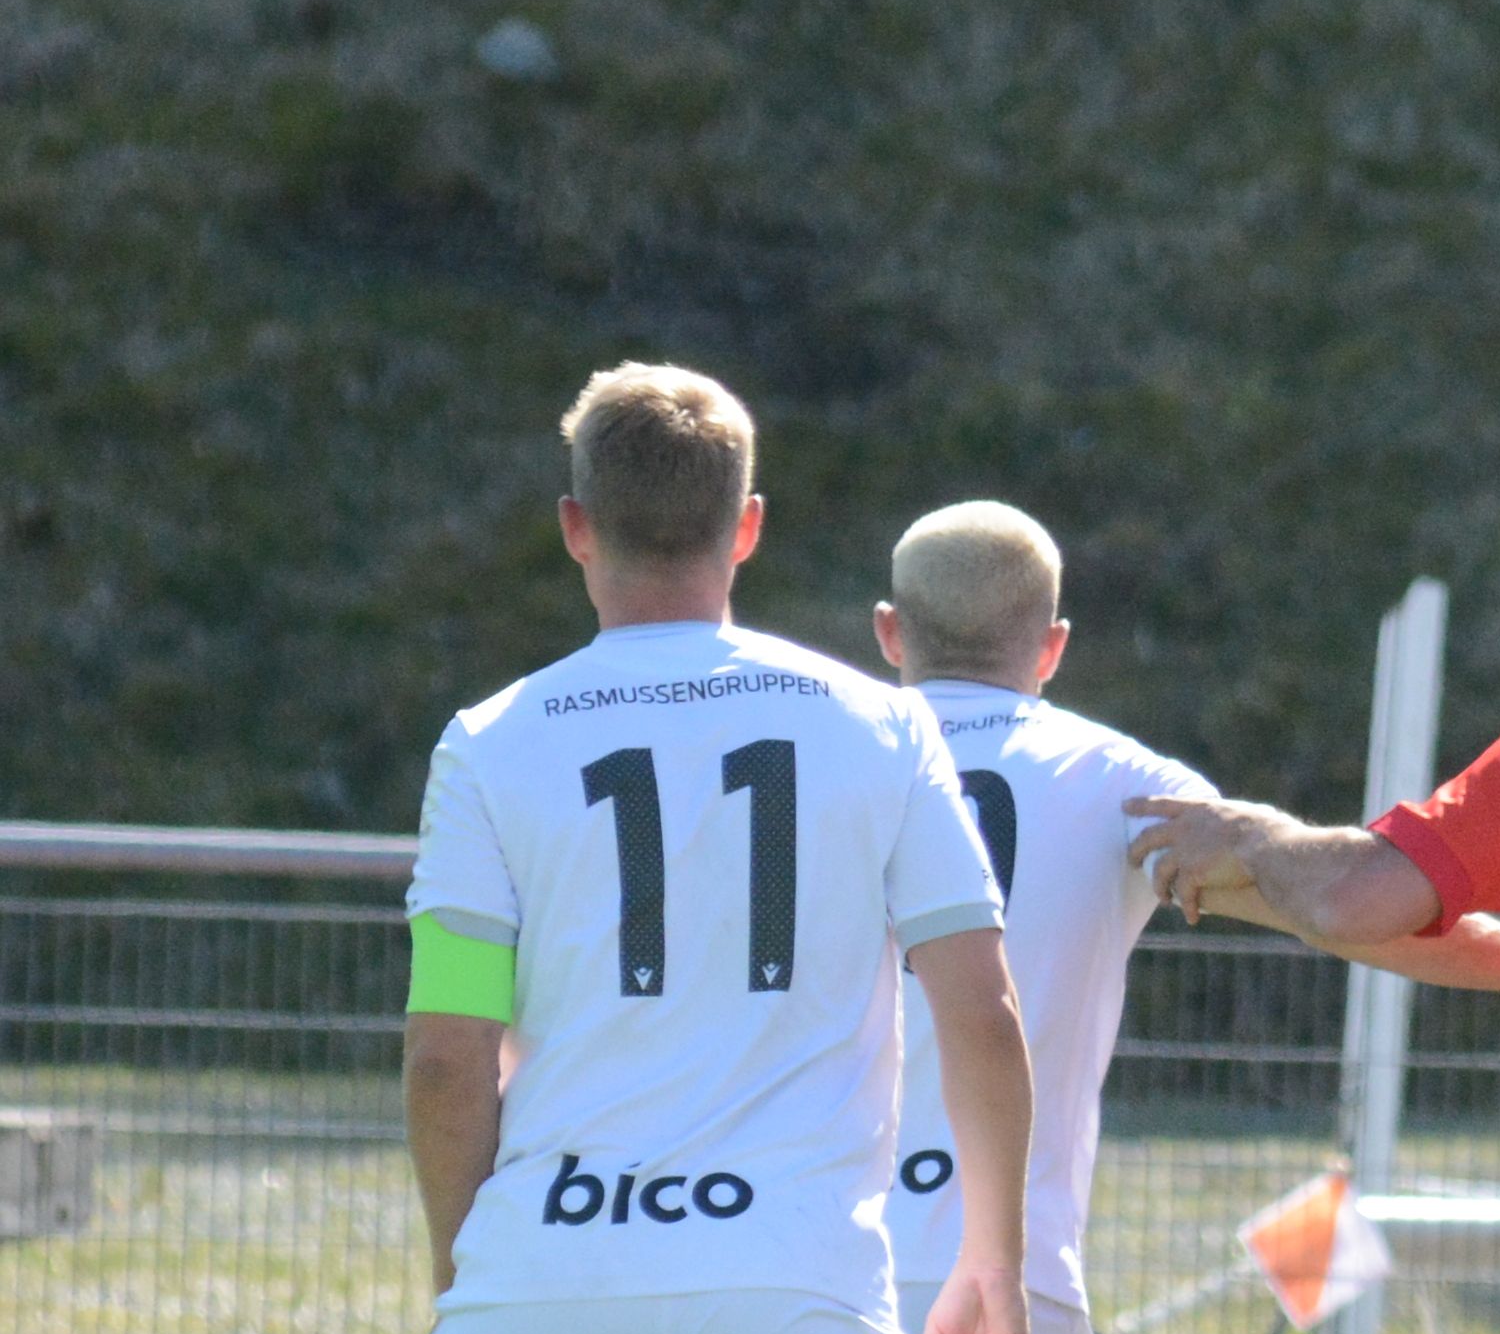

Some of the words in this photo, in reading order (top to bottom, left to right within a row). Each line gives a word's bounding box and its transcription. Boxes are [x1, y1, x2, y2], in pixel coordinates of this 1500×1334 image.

[544, 673, 830, 718] RASMUSSENGRUPPEN
[580, 739, 797, 997] 11
[542, 1154, 754, 1226] bico
